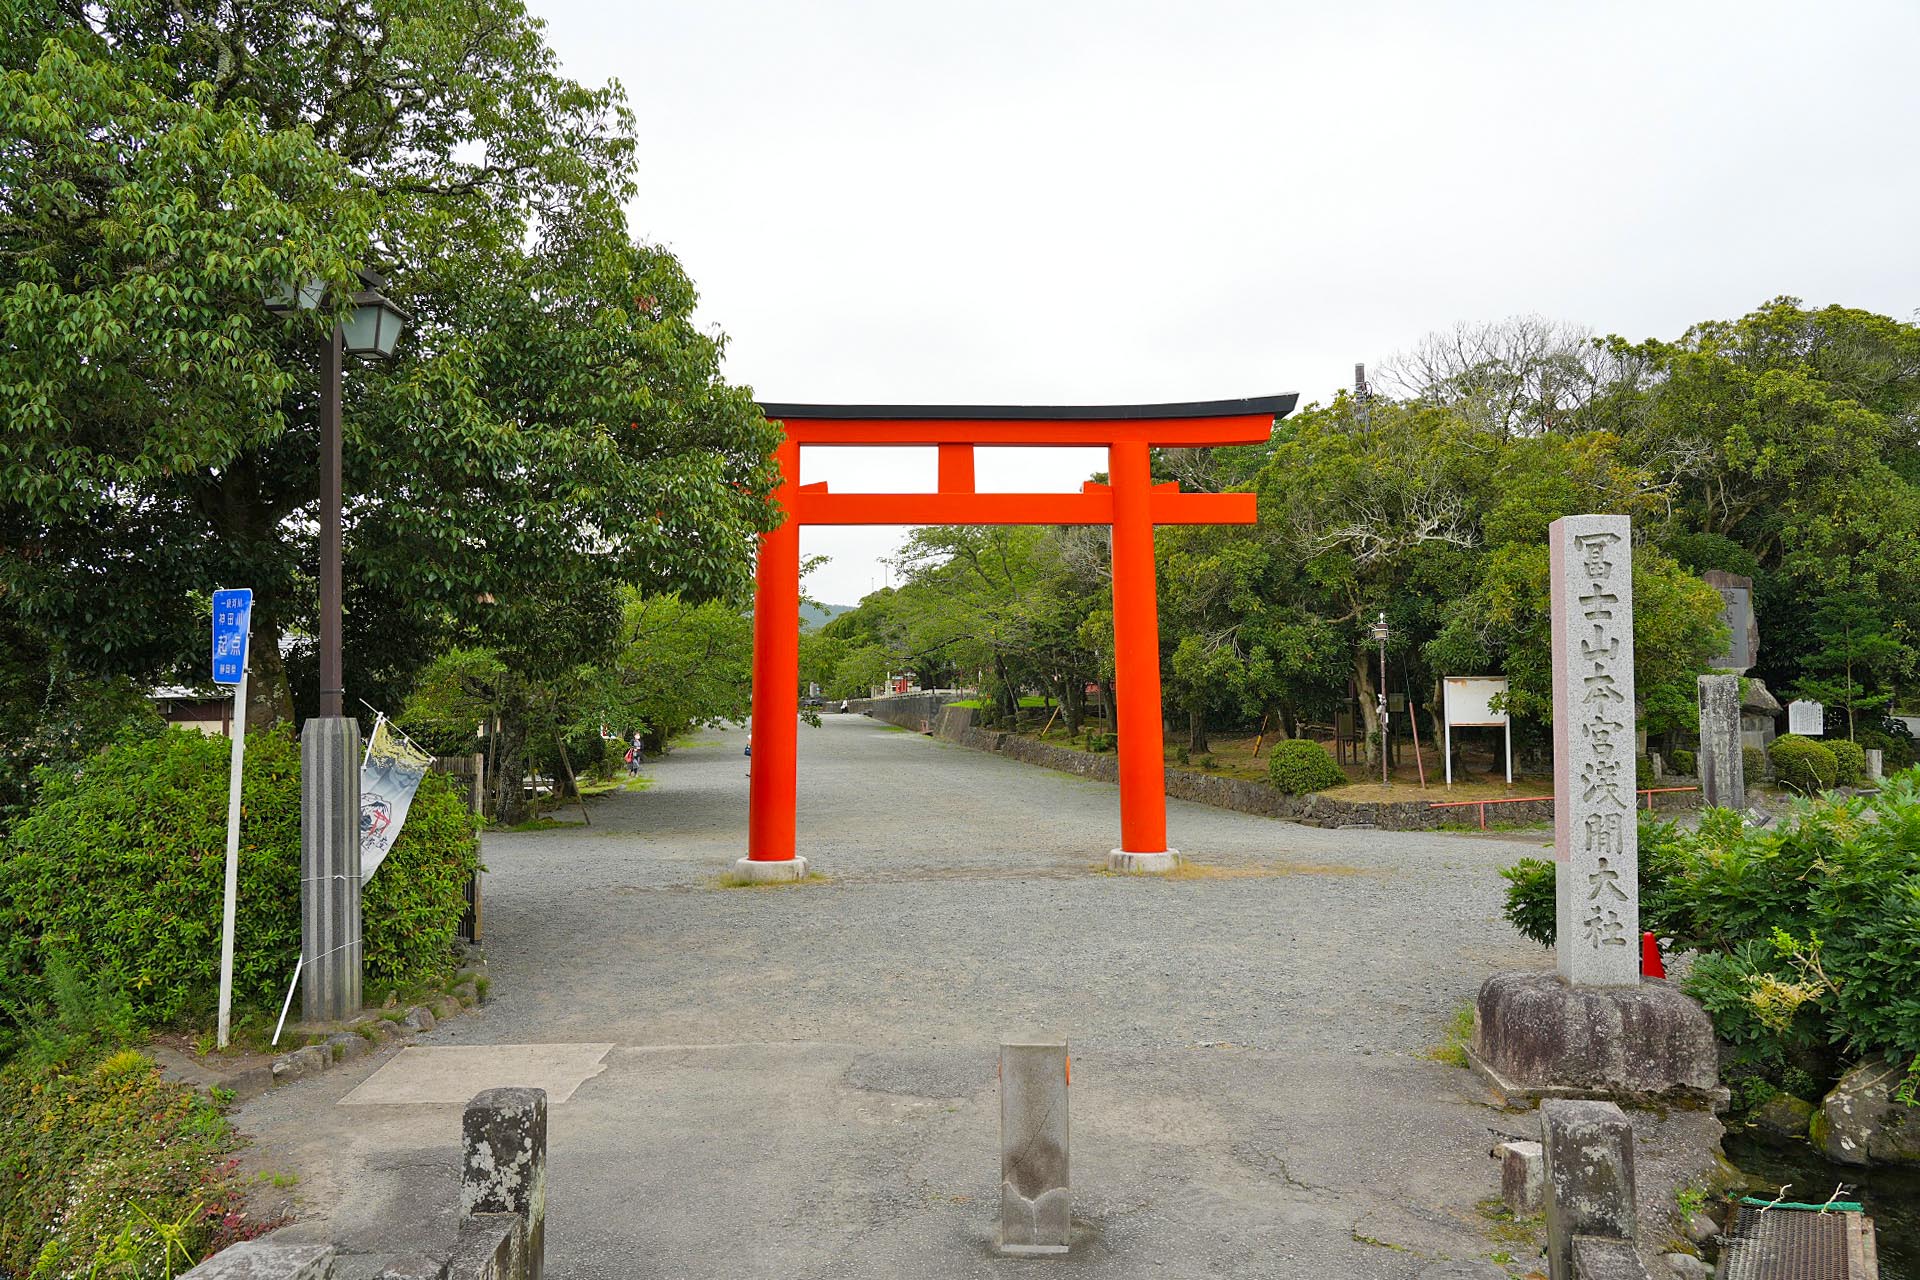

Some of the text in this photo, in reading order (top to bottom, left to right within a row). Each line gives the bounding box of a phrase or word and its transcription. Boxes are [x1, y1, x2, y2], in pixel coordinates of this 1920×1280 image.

[220, 597, 243, 609] 一級河川
[218, 612, 243, 626] 神田川
[218, 635, 241, 656] 起点
